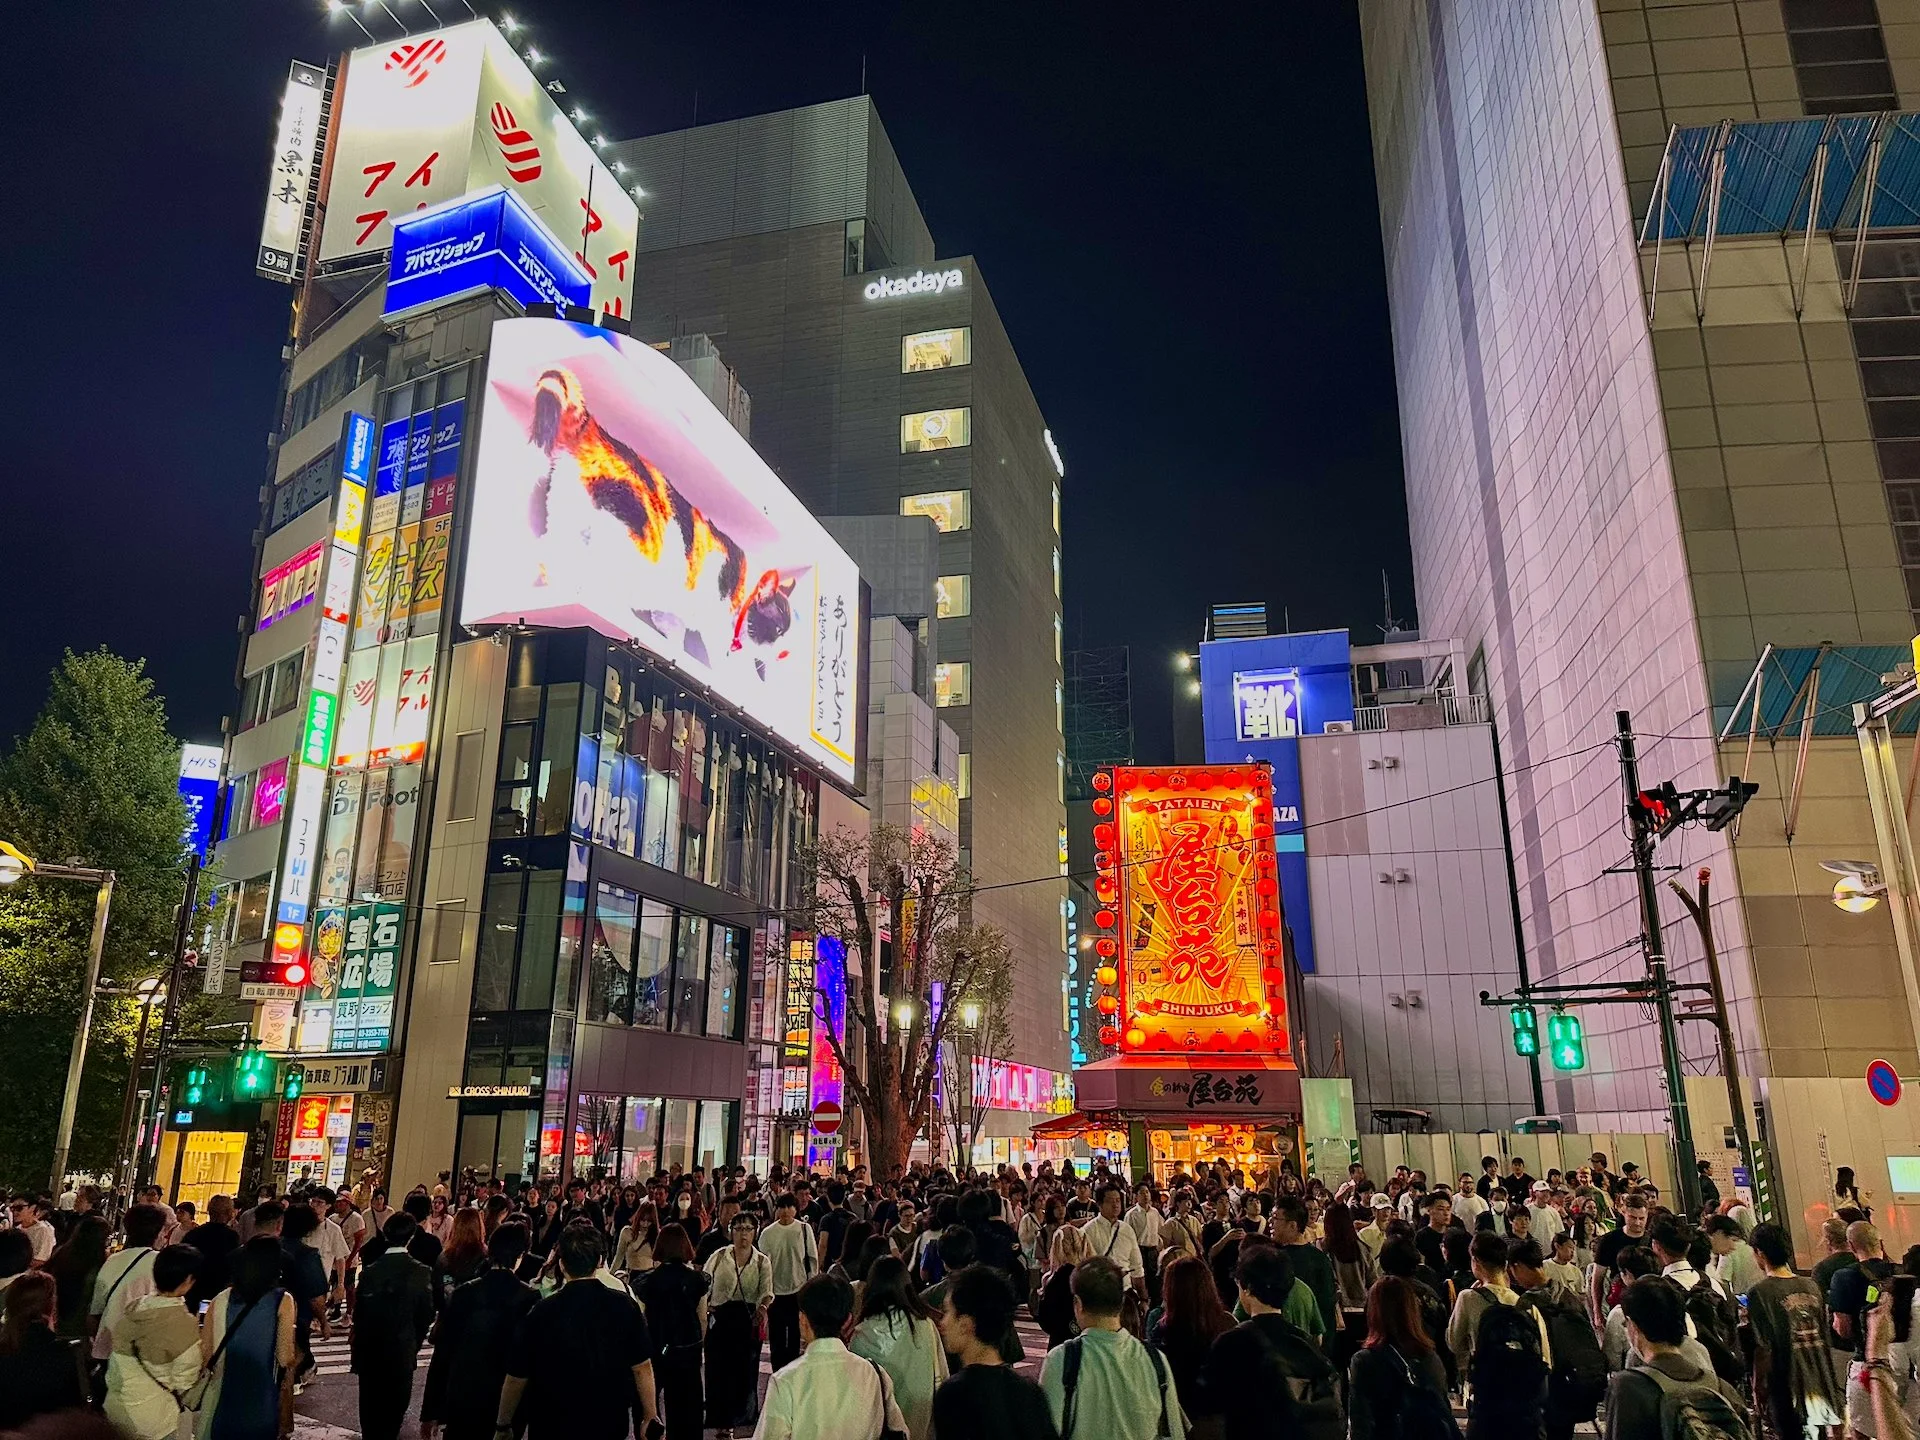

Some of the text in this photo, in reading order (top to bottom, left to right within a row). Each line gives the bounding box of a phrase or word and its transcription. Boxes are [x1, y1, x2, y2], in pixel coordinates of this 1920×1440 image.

[273, 150, 303, 205] 黒木
[404, 232, 486, 273] アパマンショップ
[864, 269, 963, 300] okadaya
[435, 519, 450, 533] 5F
[1240, 684, 1296, 738] 靴
[333, 786, 419, 816] Dr Foot
[1153, 799, 1223, 813] YATAIEN
[1273, 806, 1299, 822] AZA
[357, 870, 407, 882] ドクーフット
[1156, 821, 1234, 992] 屋台苑
[347, 913, 400, 951] 宝石
[209, 942, 223, 991] スクランブル式
[341, 951, 394, 990] 広場
[245, 987, 296, 998] 自転車専用
[1160, 1002, 1234, 1016] SHINJUKU
[373, 1067, 383, 1083] 1F
[464, 1086, 531, 1097] CROSS SHINJUKU
[1186, 1072, 1265, 1109] 屋台苑
